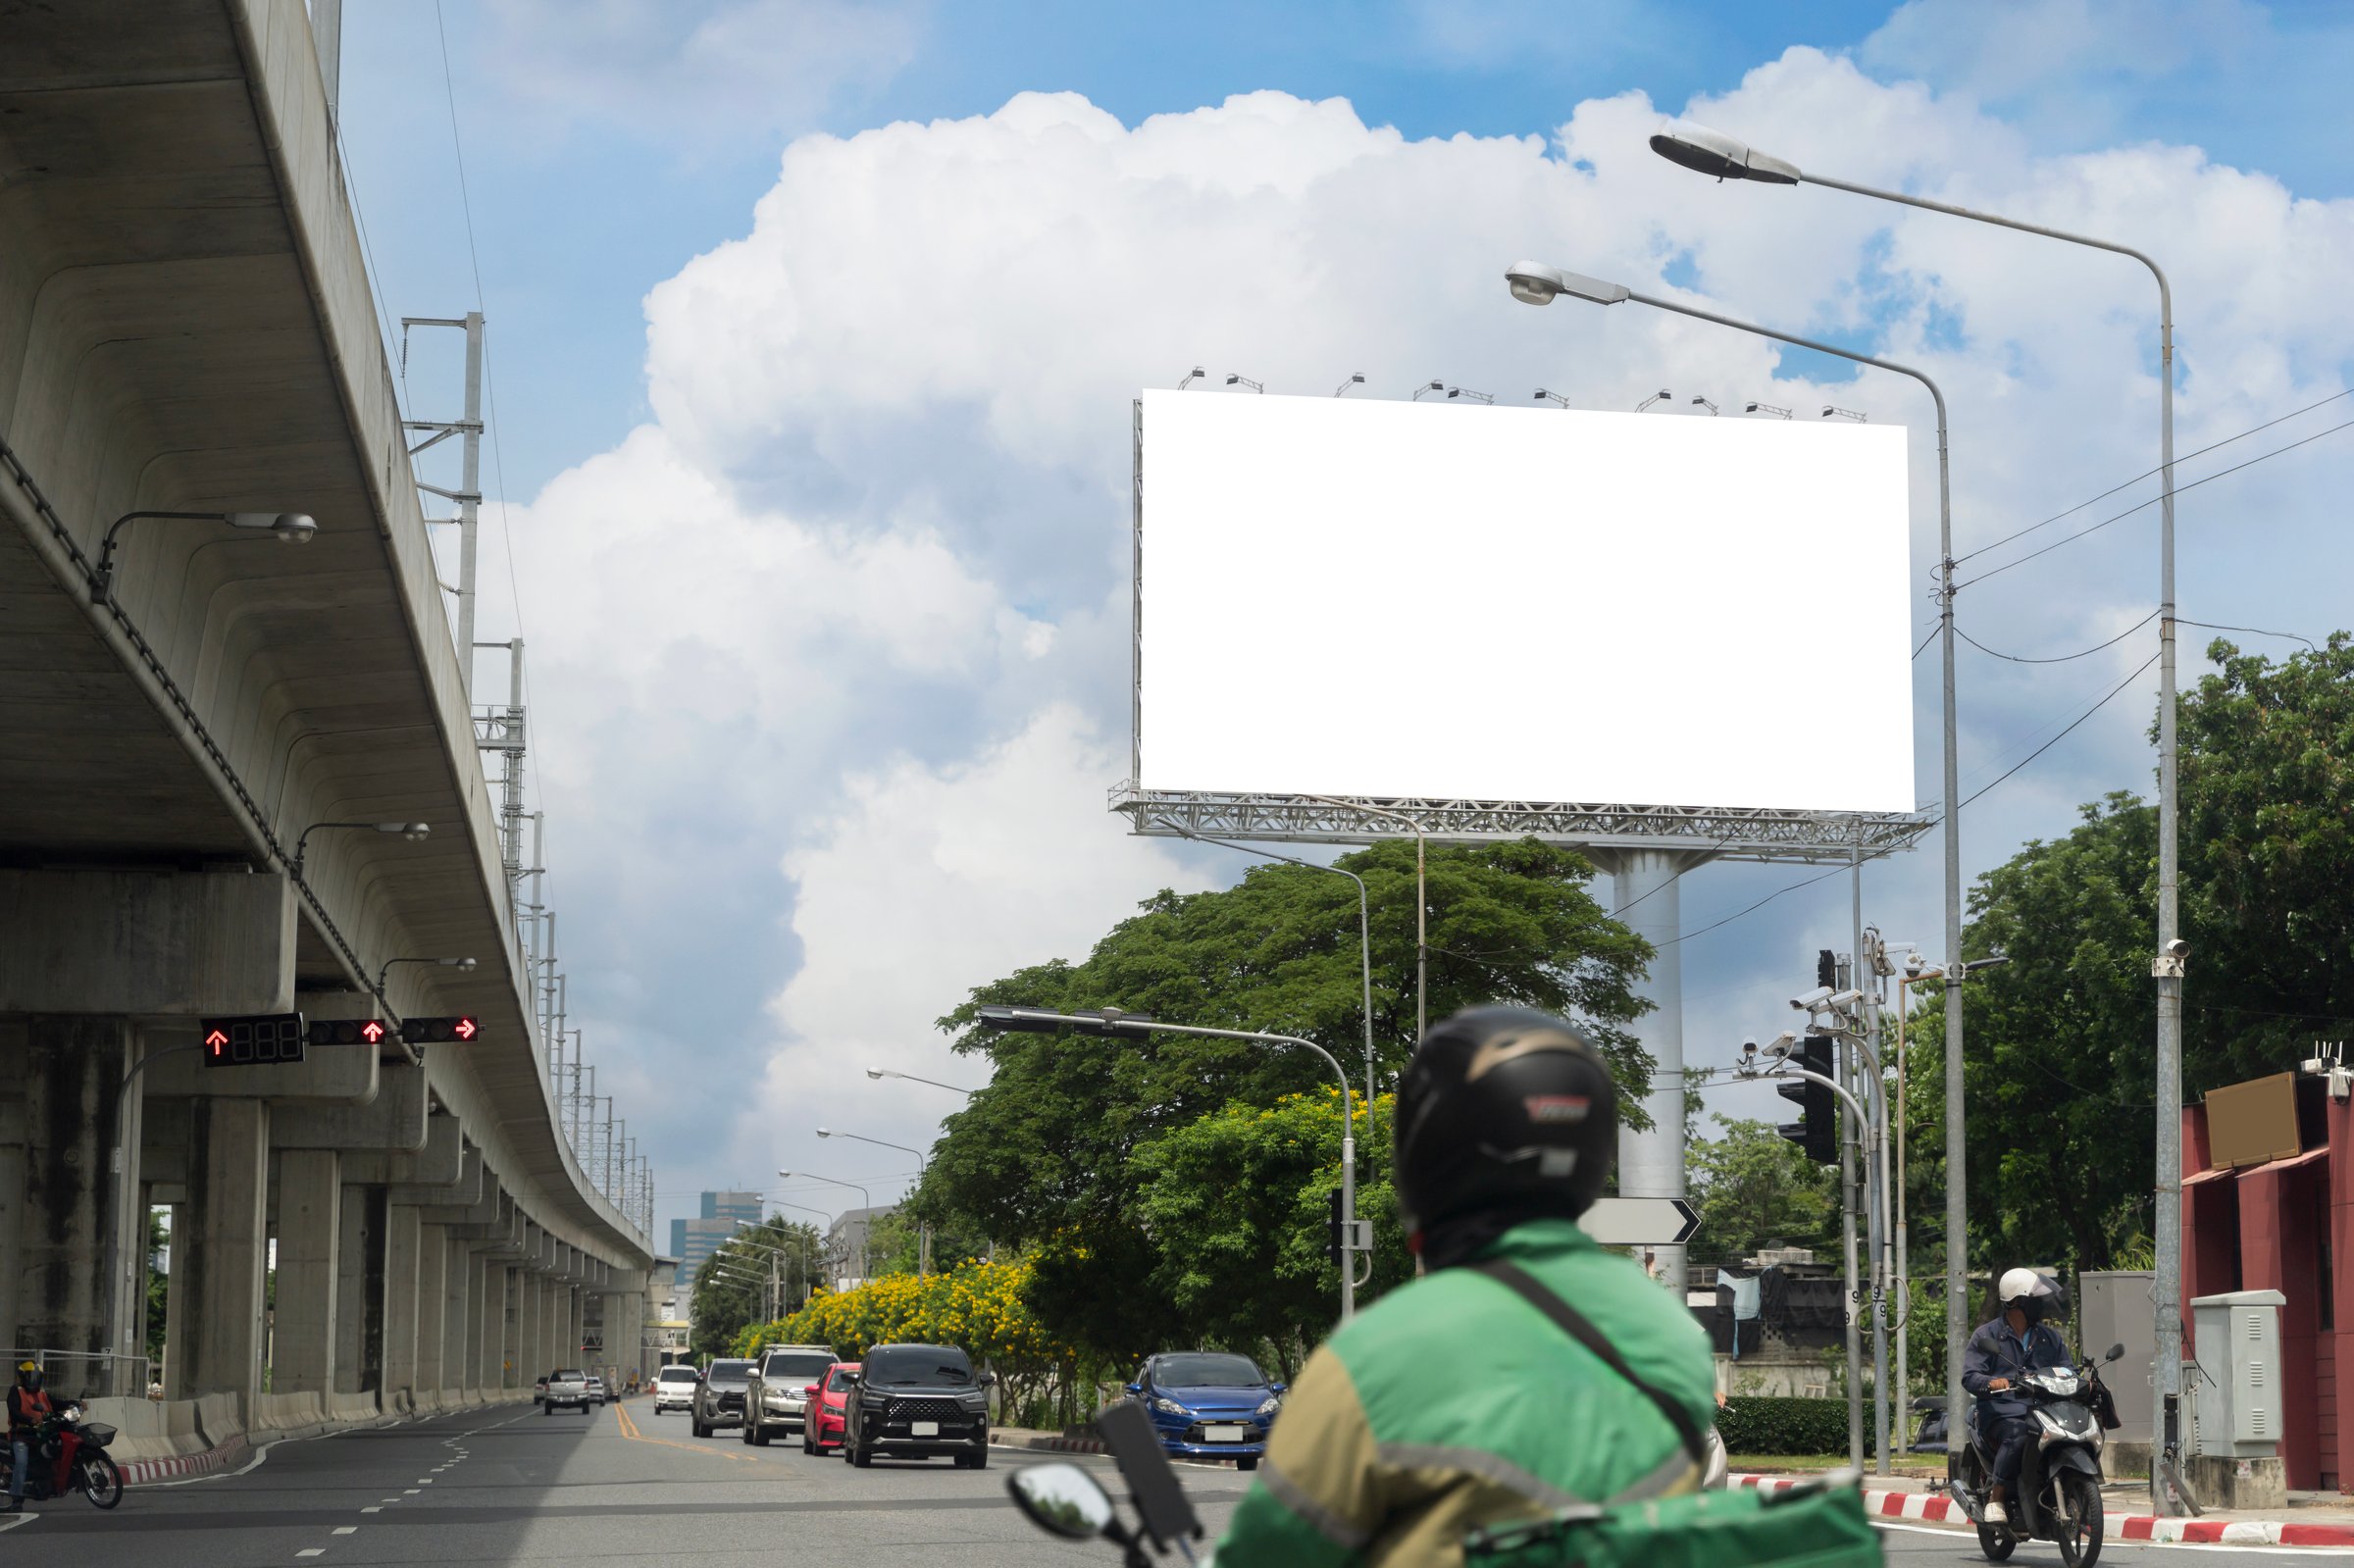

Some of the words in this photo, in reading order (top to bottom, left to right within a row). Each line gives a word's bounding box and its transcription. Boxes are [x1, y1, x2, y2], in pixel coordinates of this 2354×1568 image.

[1852, 1290, 1859, 1303] 9
[1873, 1286, 1881, 1299] 9
[1879, 1304, 1886, 1317] 9
